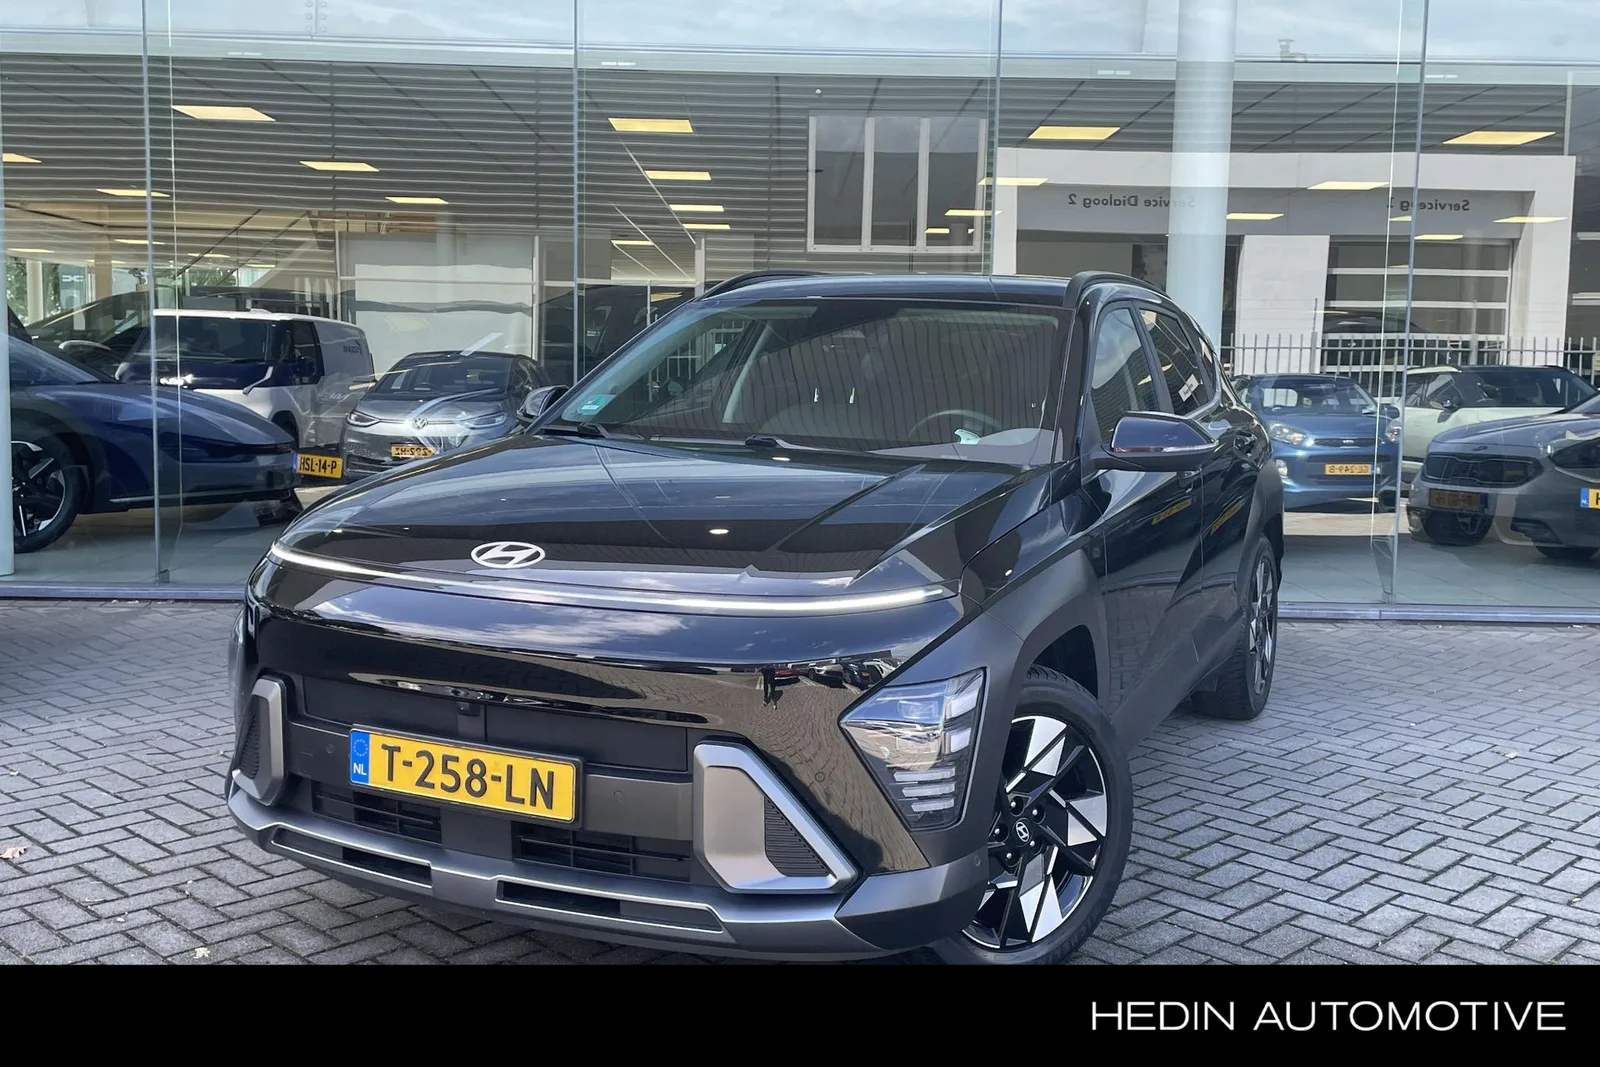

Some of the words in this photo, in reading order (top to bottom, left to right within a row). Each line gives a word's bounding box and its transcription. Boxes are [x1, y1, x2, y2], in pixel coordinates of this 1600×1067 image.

[299, 456, 338, 475] HSL-14-P
[353, 763, 367, 776] NL
[381, 743, 555, 810] T-258-LN
